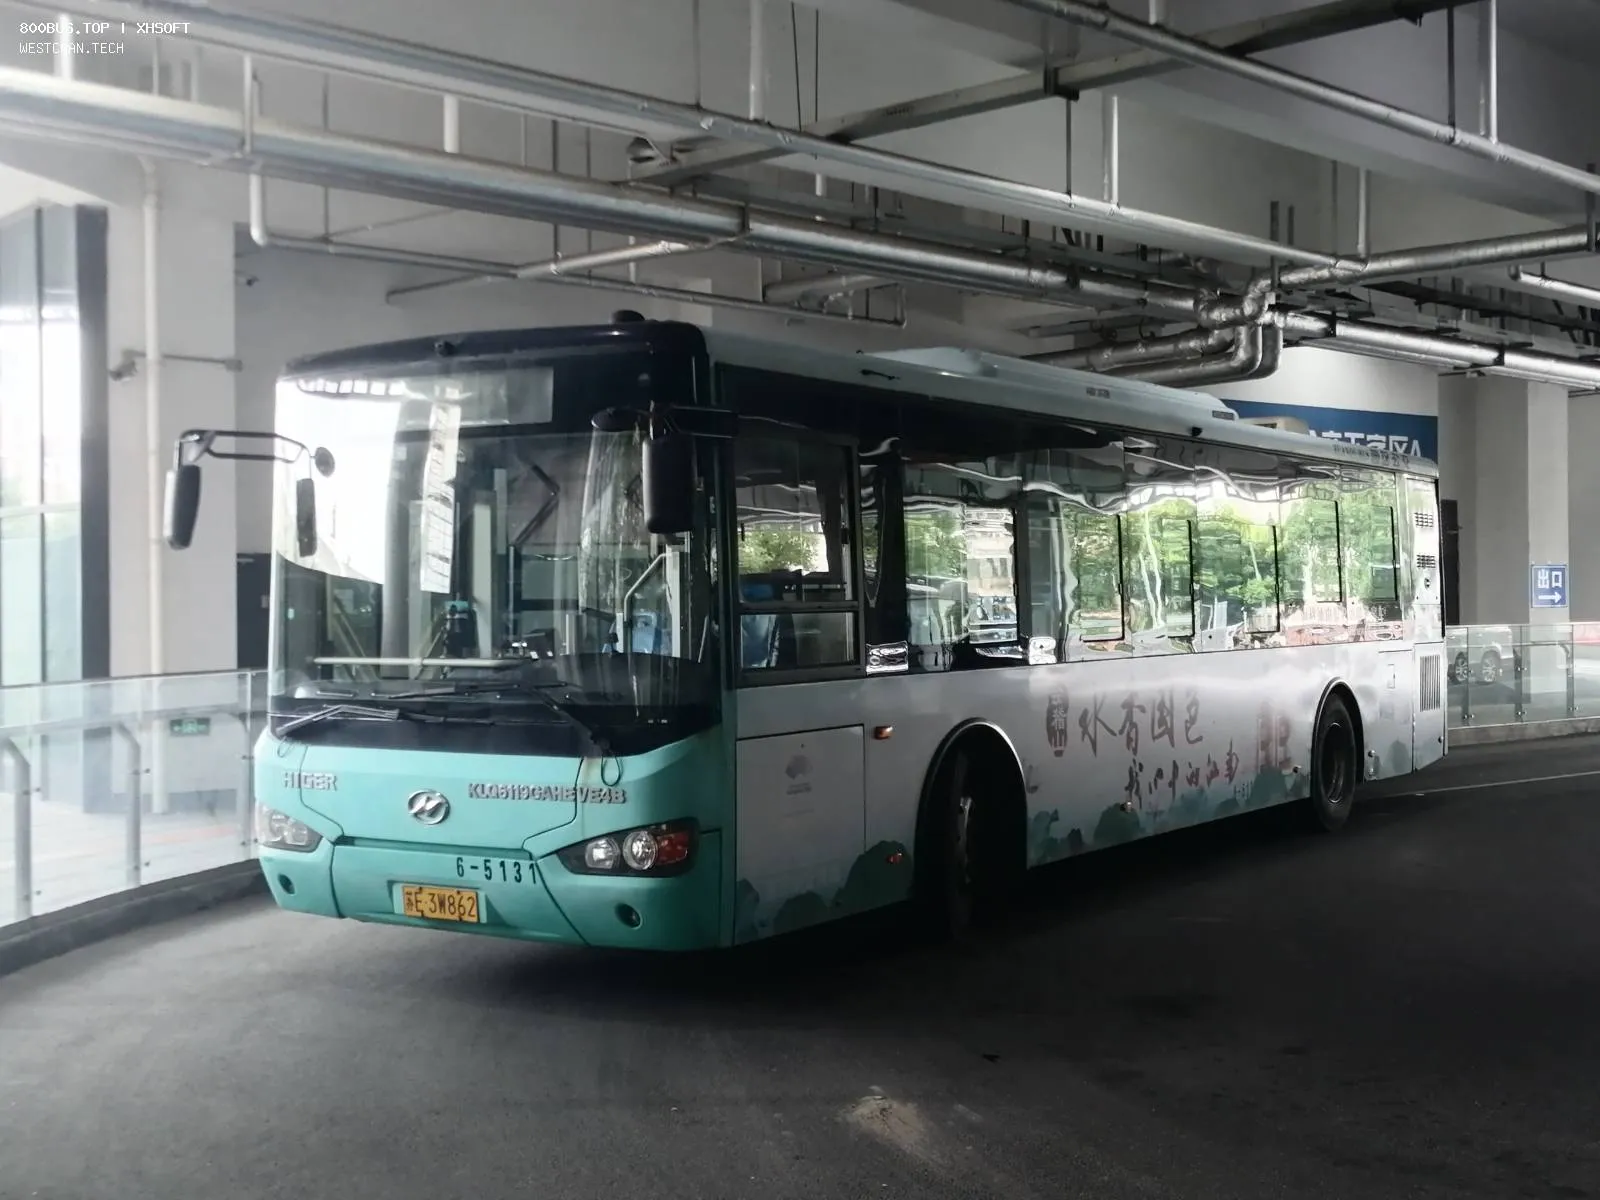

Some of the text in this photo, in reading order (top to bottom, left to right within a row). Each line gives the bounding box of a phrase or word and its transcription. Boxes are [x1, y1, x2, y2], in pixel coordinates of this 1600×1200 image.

[1537, 568, 1563, 589] 出口
[283, 772, 338, 791] HIGER
[456, 856, 537, 885] 6-5131
